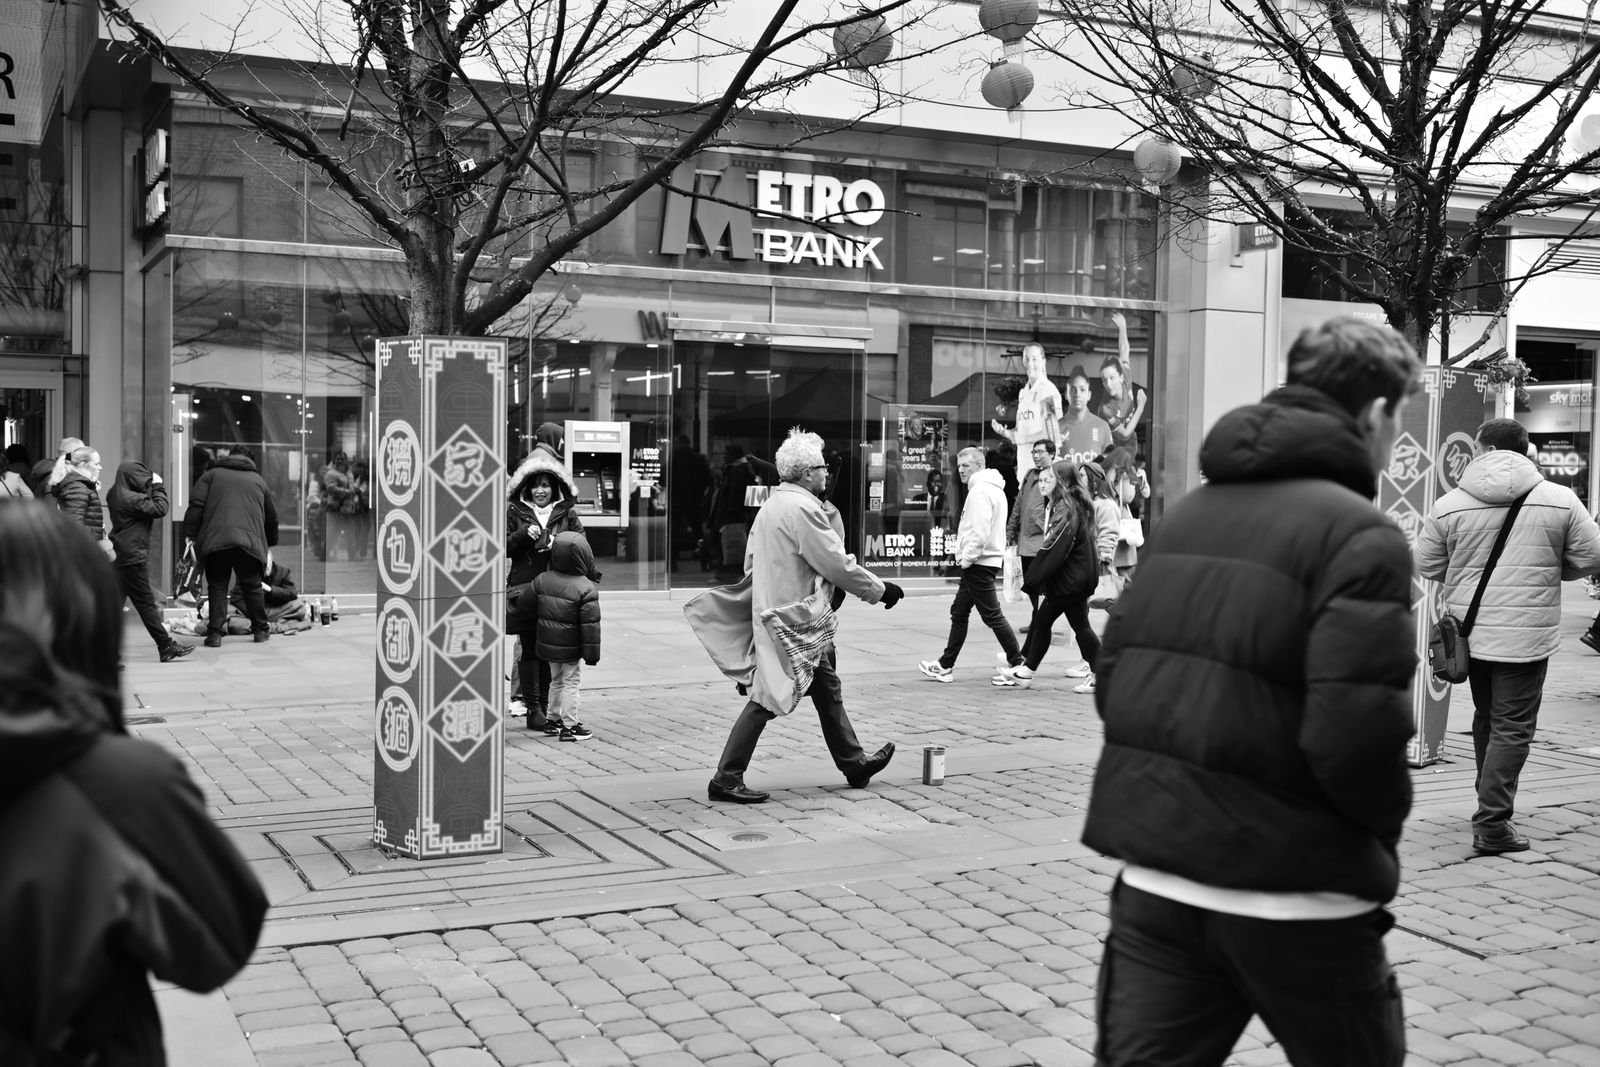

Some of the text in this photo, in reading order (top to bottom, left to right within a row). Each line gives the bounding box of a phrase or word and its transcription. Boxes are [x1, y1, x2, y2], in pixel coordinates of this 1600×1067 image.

[661, 164, 885, 260] METRO
[1255, 236, 1273, 246] BANK
[762, 229, 884, 270] BANK
[1549, 391, 1568, 406] sky
[908, 446, 926, 455] great
[902, 455, 920, 463] years
[865, 534, 915, 557] METRO
[886, 547, 915, 557] BANK
